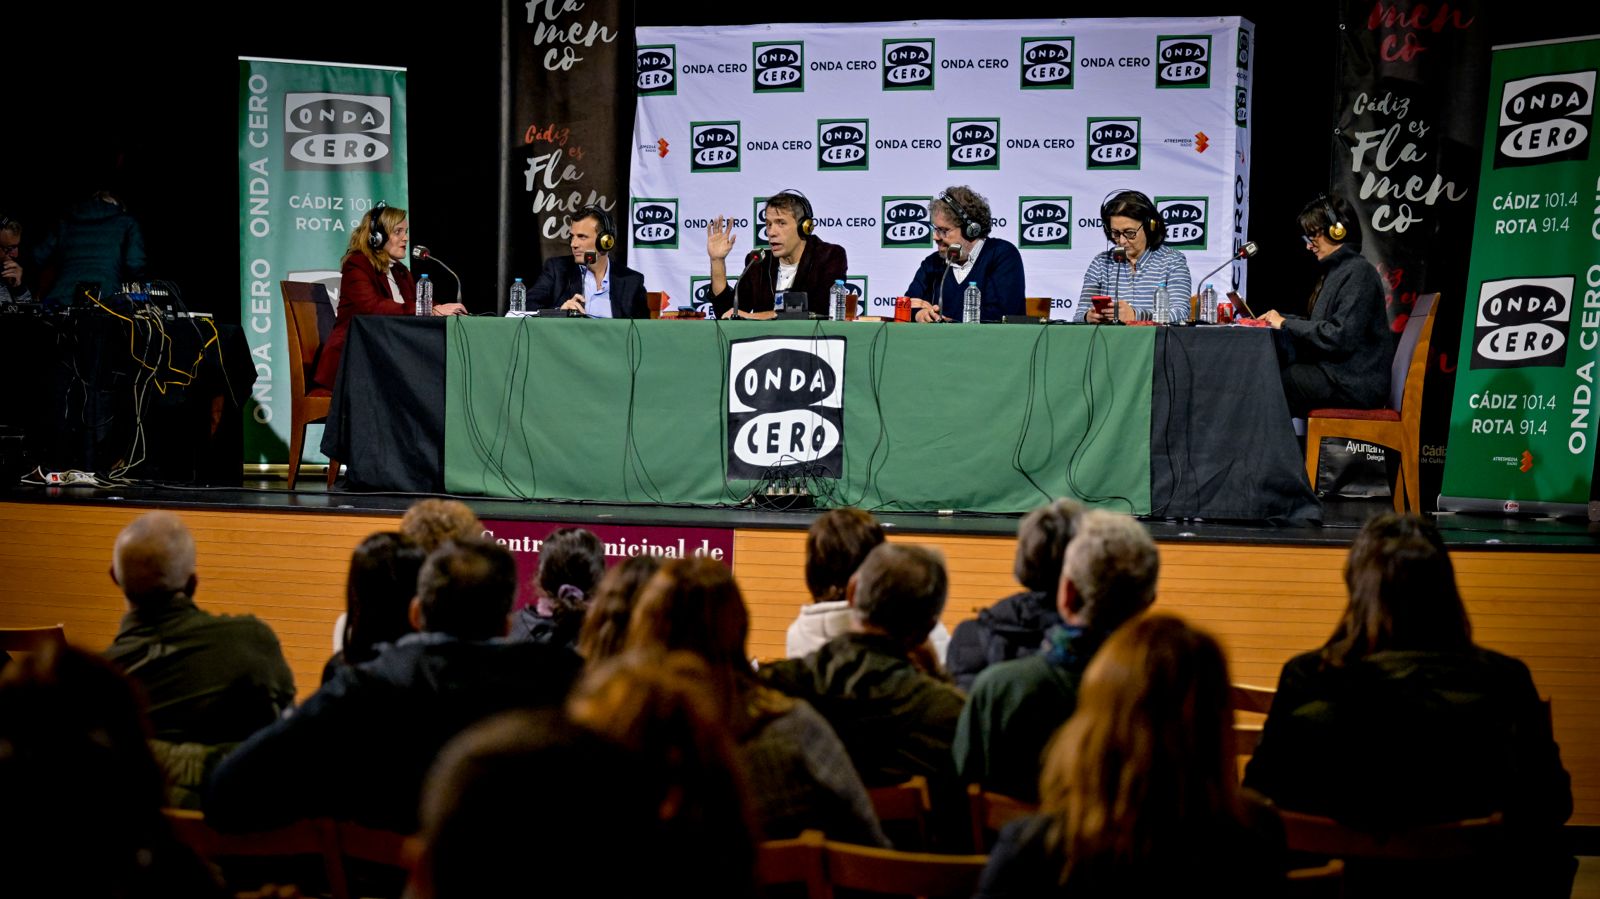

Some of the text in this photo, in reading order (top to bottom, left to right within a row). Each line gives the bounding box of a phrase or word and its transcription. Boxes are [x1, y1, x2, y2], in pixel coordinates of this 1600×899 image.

[1368, 0, 1476, 33] men
[533, 21, 618, 47] men
[1029, 48, 1066, 60] ONDA
[1165, 47, 1202, 58] ONDA
[1380, 32, 1427, 63] co
[543, 46, 584, 72] co
[761, 52, 795, 64] ONDA
[890, 50, 926, 62] ONDA
[1080, 57, 1151, 68] ONDA CERO
[682, 62, 748, 75] ONDA CERO
[810, 60, 878, 72] ONDA CERO
[940, 58, 1010, 70] ONDA CERO
[762, 70, 795, 83] CERO
[892, 68, 926, 81] CERO
[1030, 66, 1066, 79] CERO
[1166, 65, 1202, 78] CERO
[1353, 91, 1411, 119] Cádiz
[1512, 91, 1580, 116] ONDA
[299, 107, 377, 125] ONDA
[524, 123, 571, 145] Cádiz
[956, 129, 992, 141] ONDA
[1095, 129, 1132, 140] ONDA
[1408, 119, 1430, 138] es
[698, 132, 732, 144] ONDA
[825, 130, 860, 142] ONDA
[1512, 126, 1577, 152] CERO
[303, 138, 377, 159] CERO
[746, 140, 813, 151] ONDA CERO
[875, 138, 942, 149] ONDA CERO
[1006, 138, 1076, 149] ONDA CERO
[1350, 123, 1428, 173] Fla
[248, 73, 271, 238] ONDA CERO
[568, 146, 586, 161] es
[700, 149, 733, 162] CERO
[827, 148, 860, 161] CERO
[957, 146, 991, 159] CERO
[1097, 146, 1131, 159] CERO
[524, 148, 585, 192] Fla
[1359, 170, 1469, 206] men
[288, 192, 344, 211] CÁDIZ
[1492, 191, 1578, 211] CÁDIZ 101.4
[639, 209, 671, 220] ONDA
[890, 208, 925, 219] ONDA
[1027, 208, 1063, 219] ONDA
[1162, 209, 1199, 219] ONDA
[1371, 203, 1423, 233] co
[295, 217, 345, 232] ROTA
[813, 217, 877, 228] ONDA CERO
[990, 218, 1008, 228] RO
[1078, 218, 1105, 228] OND
[1495, 217, 1570, 235] ROTA 91.4
[640, 226, 671, 239] CERO
[891, 224, 924, 237] CERO
[1029, 226, 1063, 238] CERO
[1231, 174, 1244, 292] CERO
[873, 297, 897, 307] OND
[1050, 299, 1073, 309] ERO
[1490, 296, 1558, 316] ONDA
[251, 258, 273, 425] ONDA CERO
[1489, 331, 1554, 354] CERO
[1568, 264, 1600, 455] ONDA CERO
[743, 368, 827, 395] ONDA
[1468, 390, 1557, 410] CÁDIZ 101.4
[1471, 419, 1548, 436] ROTA 91.4
[747, 421, 827, 454] CERO
[604, 537, 684, 561] nicipal
[694, 540, 724, 561] de
